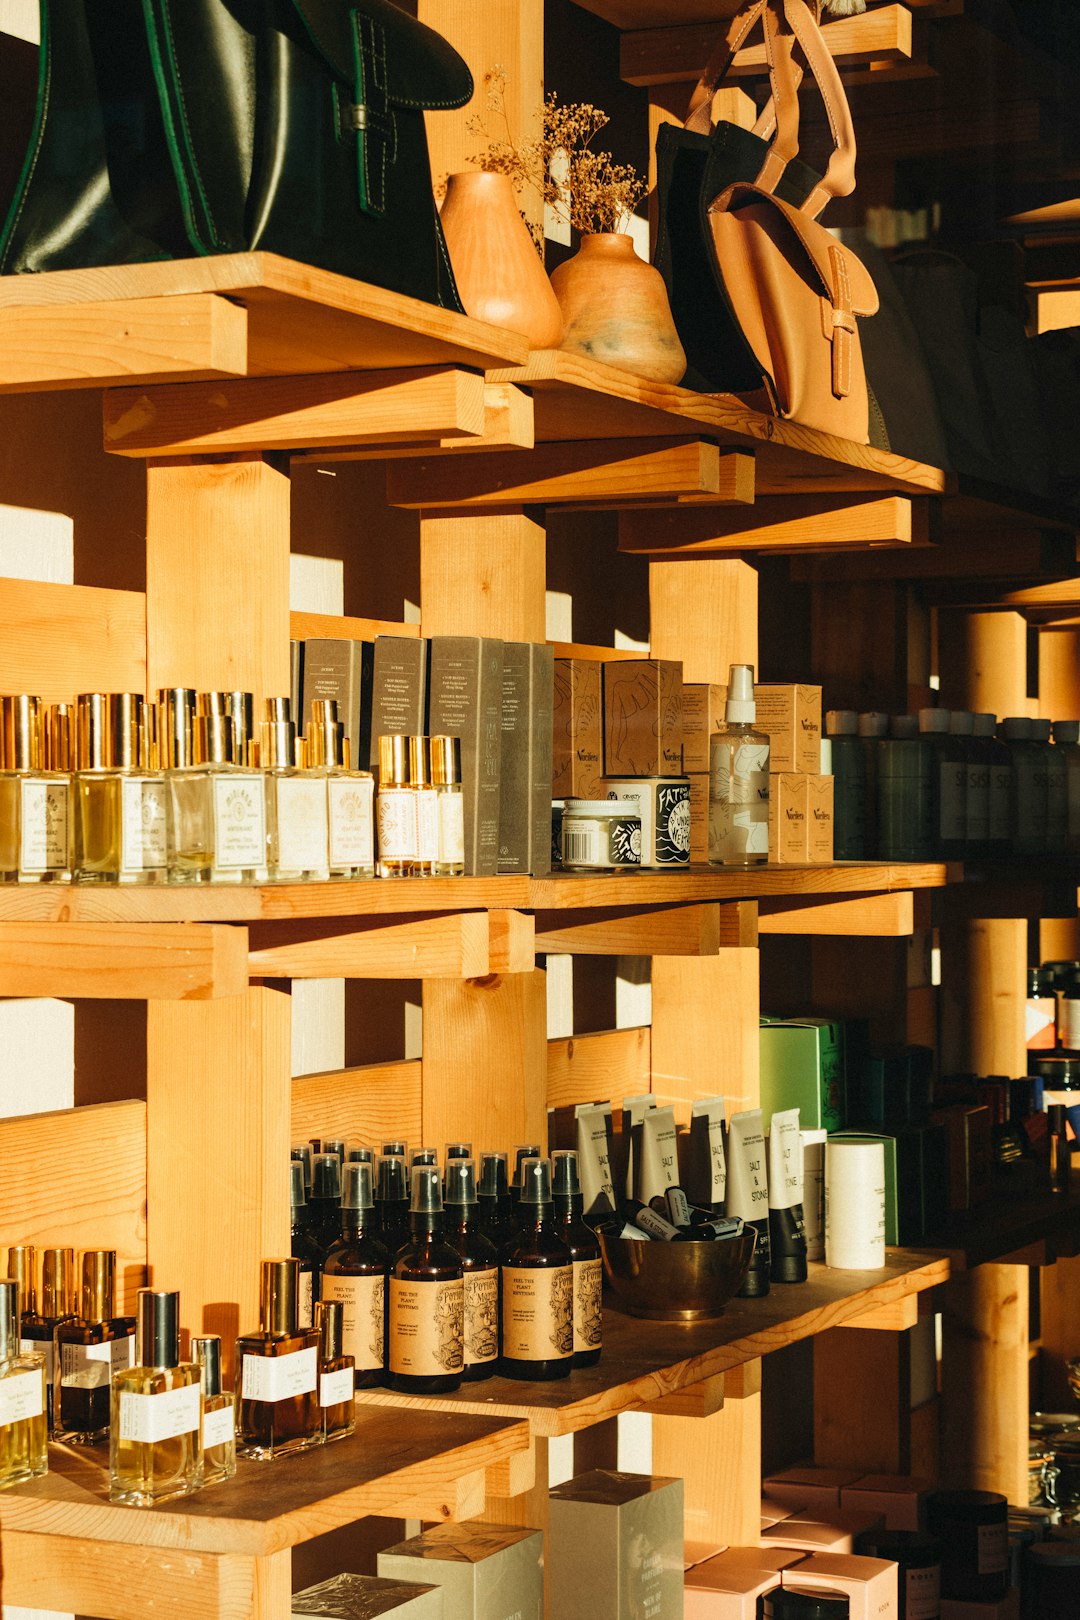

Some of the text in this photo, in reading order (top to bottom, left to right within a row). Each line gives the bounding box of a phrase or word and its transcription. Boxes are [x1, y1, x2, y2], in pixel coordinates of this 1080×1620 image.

[658, 787, 680, 813] FAT
[612, 825, 630, 854] FAT
[749, 1160, 760, 1171] SALT
[751, 1189, 768, 1202] STONE
